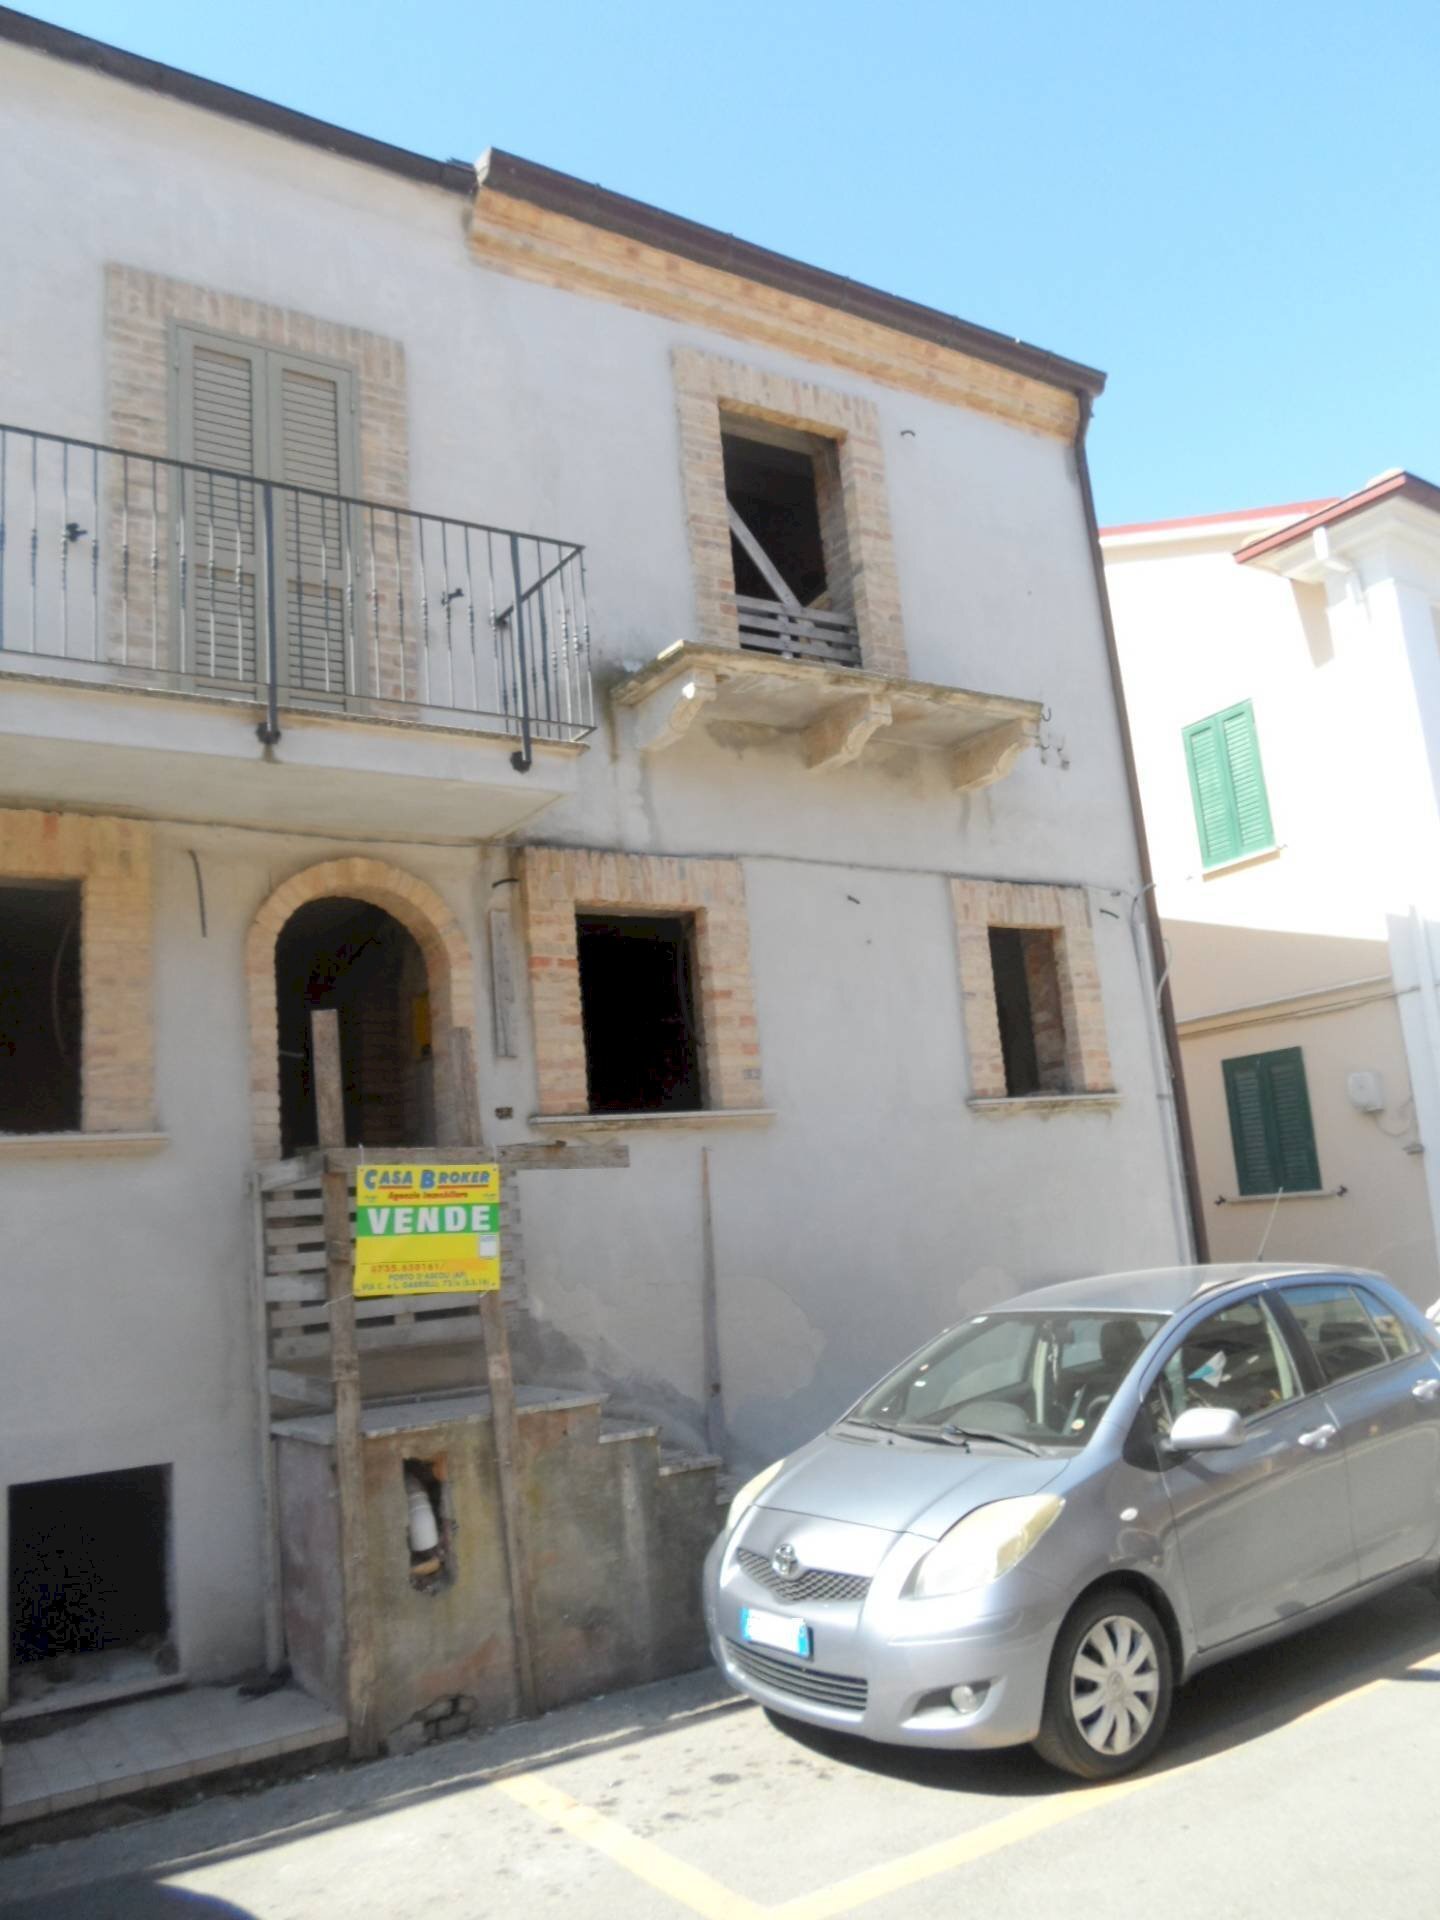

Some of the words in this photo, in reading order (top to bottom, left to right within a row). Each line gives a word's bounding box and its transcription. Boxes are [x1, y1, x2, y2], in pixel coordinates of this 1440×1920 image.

[364, 1169, 413, 1190] CASA
[420, 1169, 490, 1190] BROKER
[367, 1205, 491, 1235] VENDE
